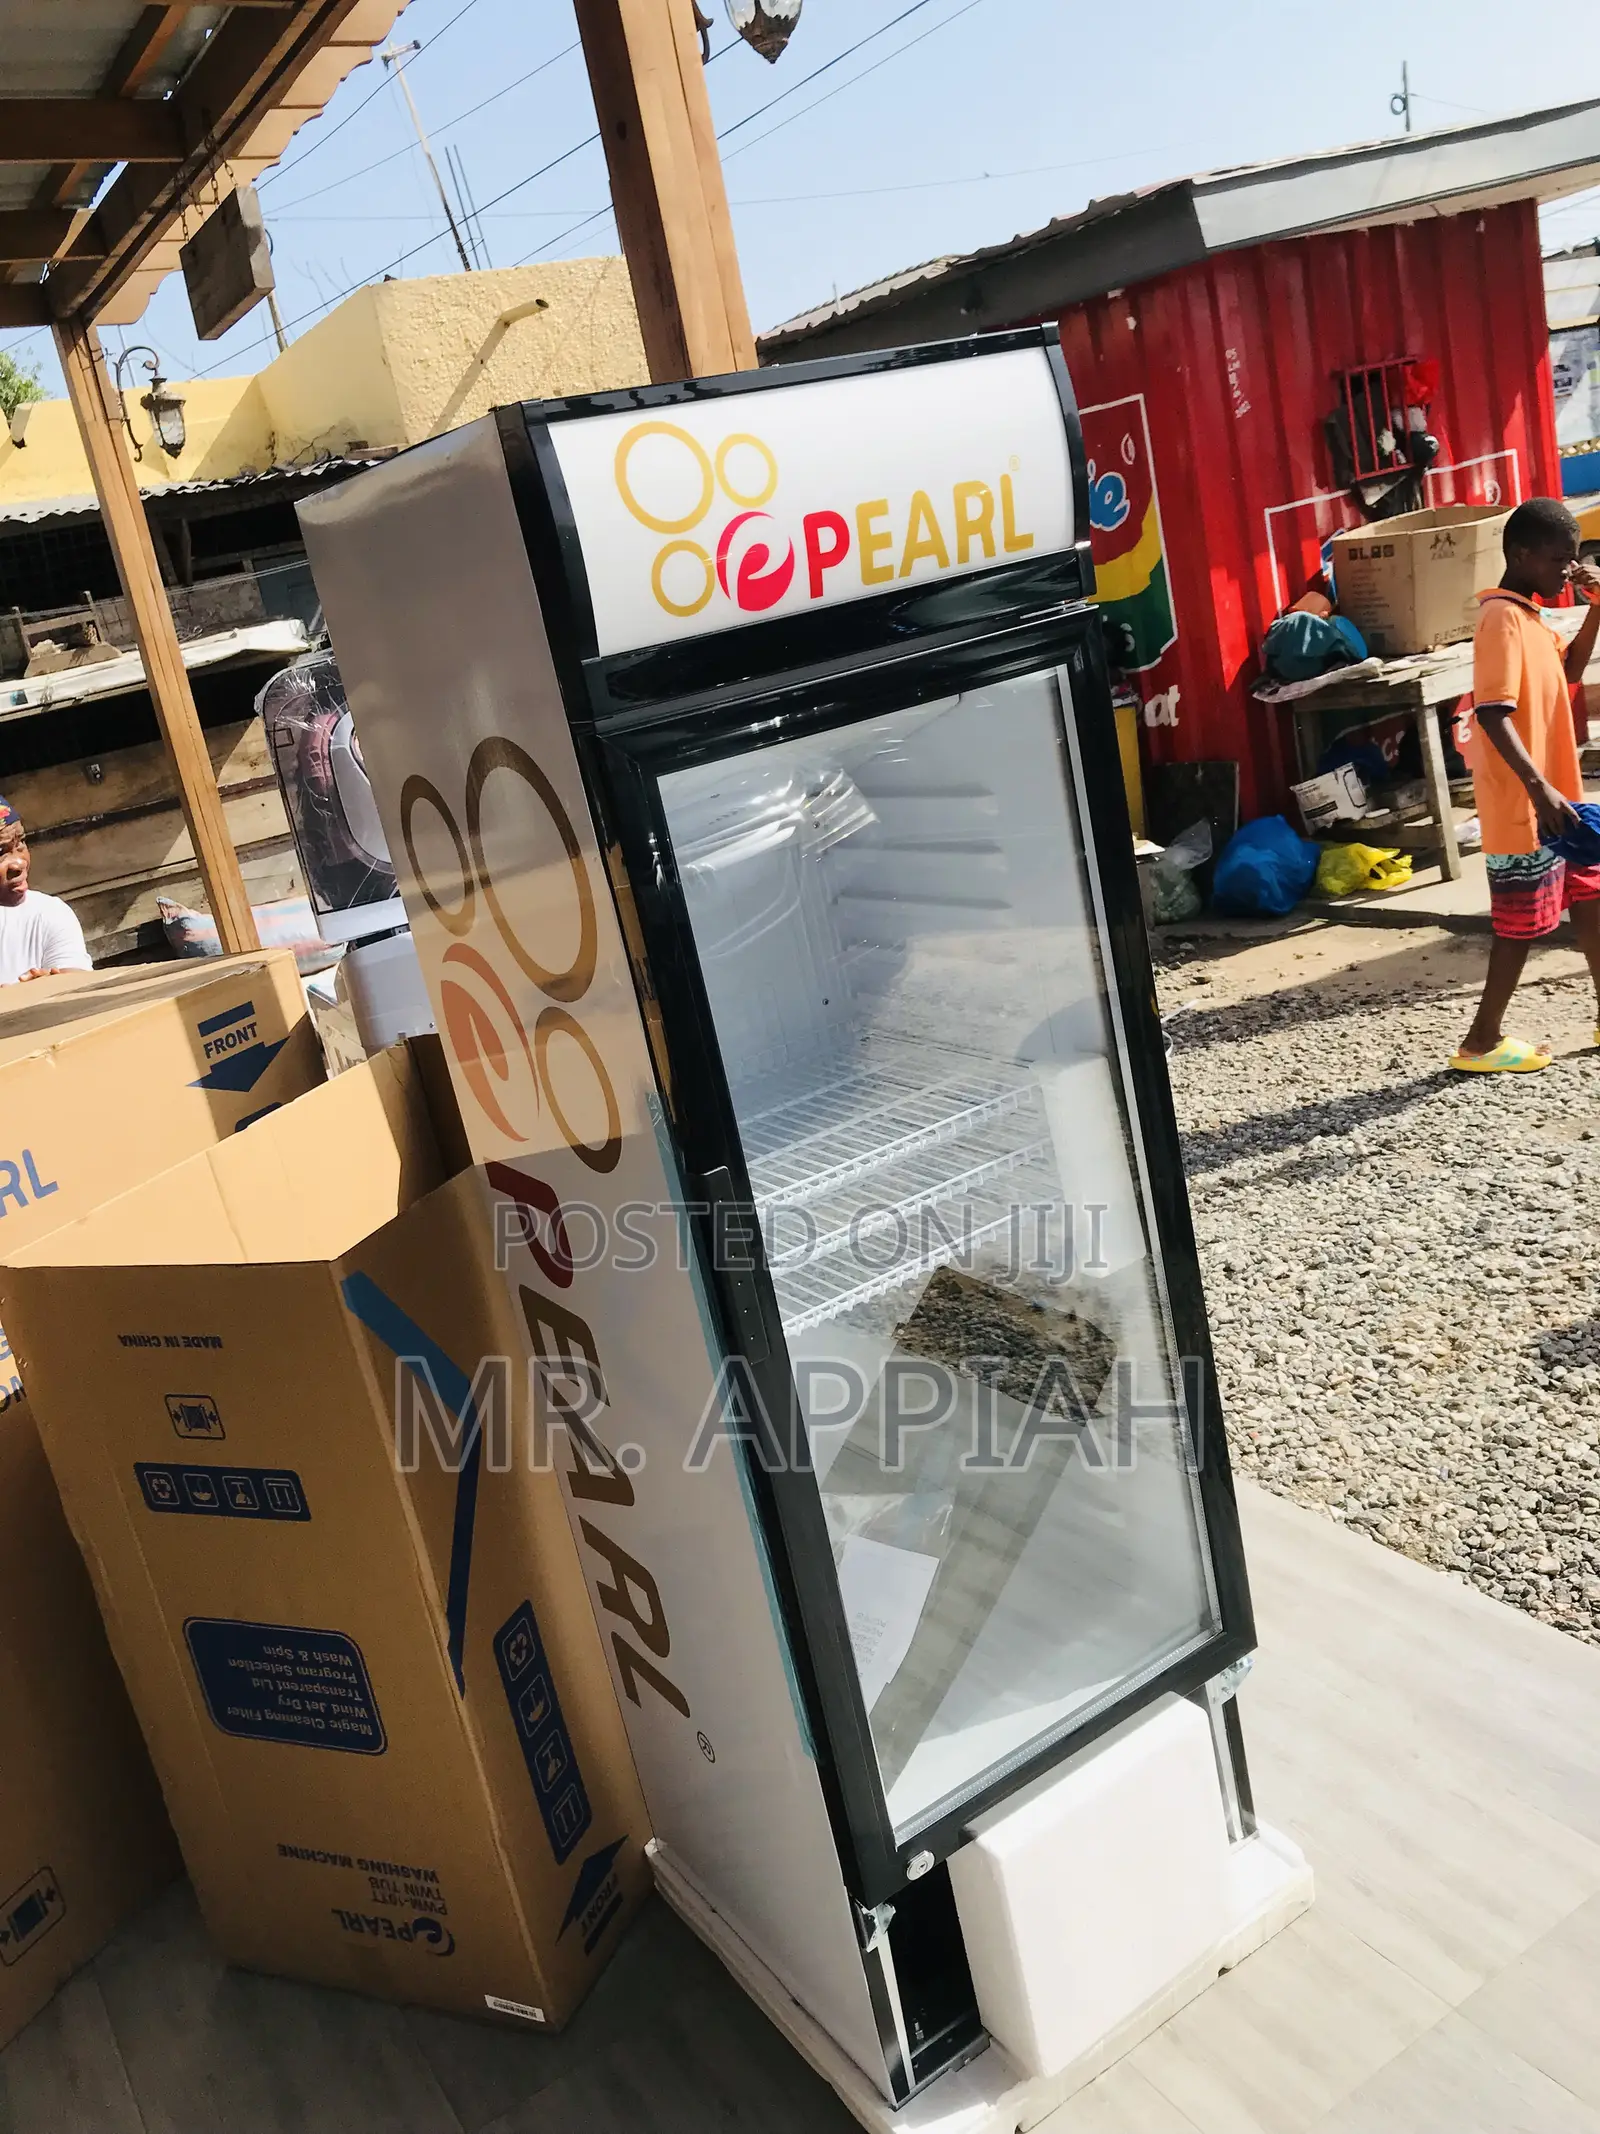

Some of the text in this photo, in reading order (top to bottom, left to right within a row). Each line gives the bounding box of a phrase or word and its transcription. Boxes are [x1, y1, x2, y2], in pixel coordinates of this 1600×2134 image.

[802, 473, 1035, 599] PEARL
[203, 1022, 257, 1059] FRONT
[117, 1334, 223, 1349] MADE IN CHINA
[483, 1157, 691, 1719] PEARL
[263, 1645, 353, 1667] Wash & Spin
[228, 1659, 358, 1684] Program Selection
[251, 1677, 363, 1701] Transparent Lid
[227, 1705, 373, 1736] Magic Cleaning Filter
[277, 1695, 368, 1719] Wind Jet Dry
[276, 1843, 440, 1884] WASHING MACHINE
[368, 1876, 446, 1900] TWIN TUB
[331, 1907, 415, 1943] PEARL
